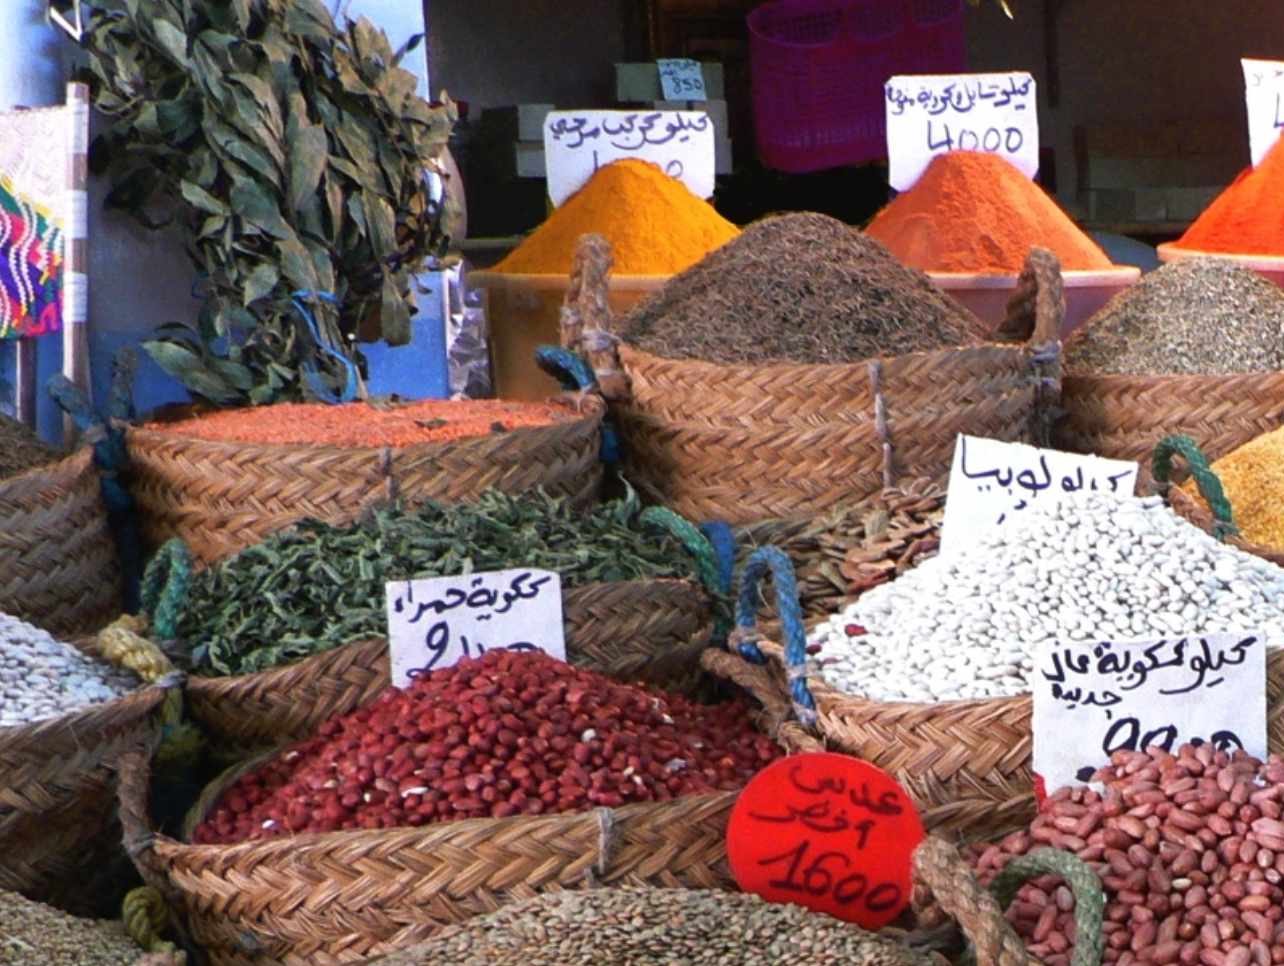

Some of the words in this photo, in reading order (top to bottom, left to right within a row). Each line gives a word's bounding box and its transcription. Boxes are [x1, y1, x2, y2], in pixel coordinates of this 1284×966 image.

[926, 120, 1024, 153] 4000
[1157, 635, 1258, 695] كيلو
[789, 763, 904, 816] عدس
[757, 839, 903, 913] 1600
